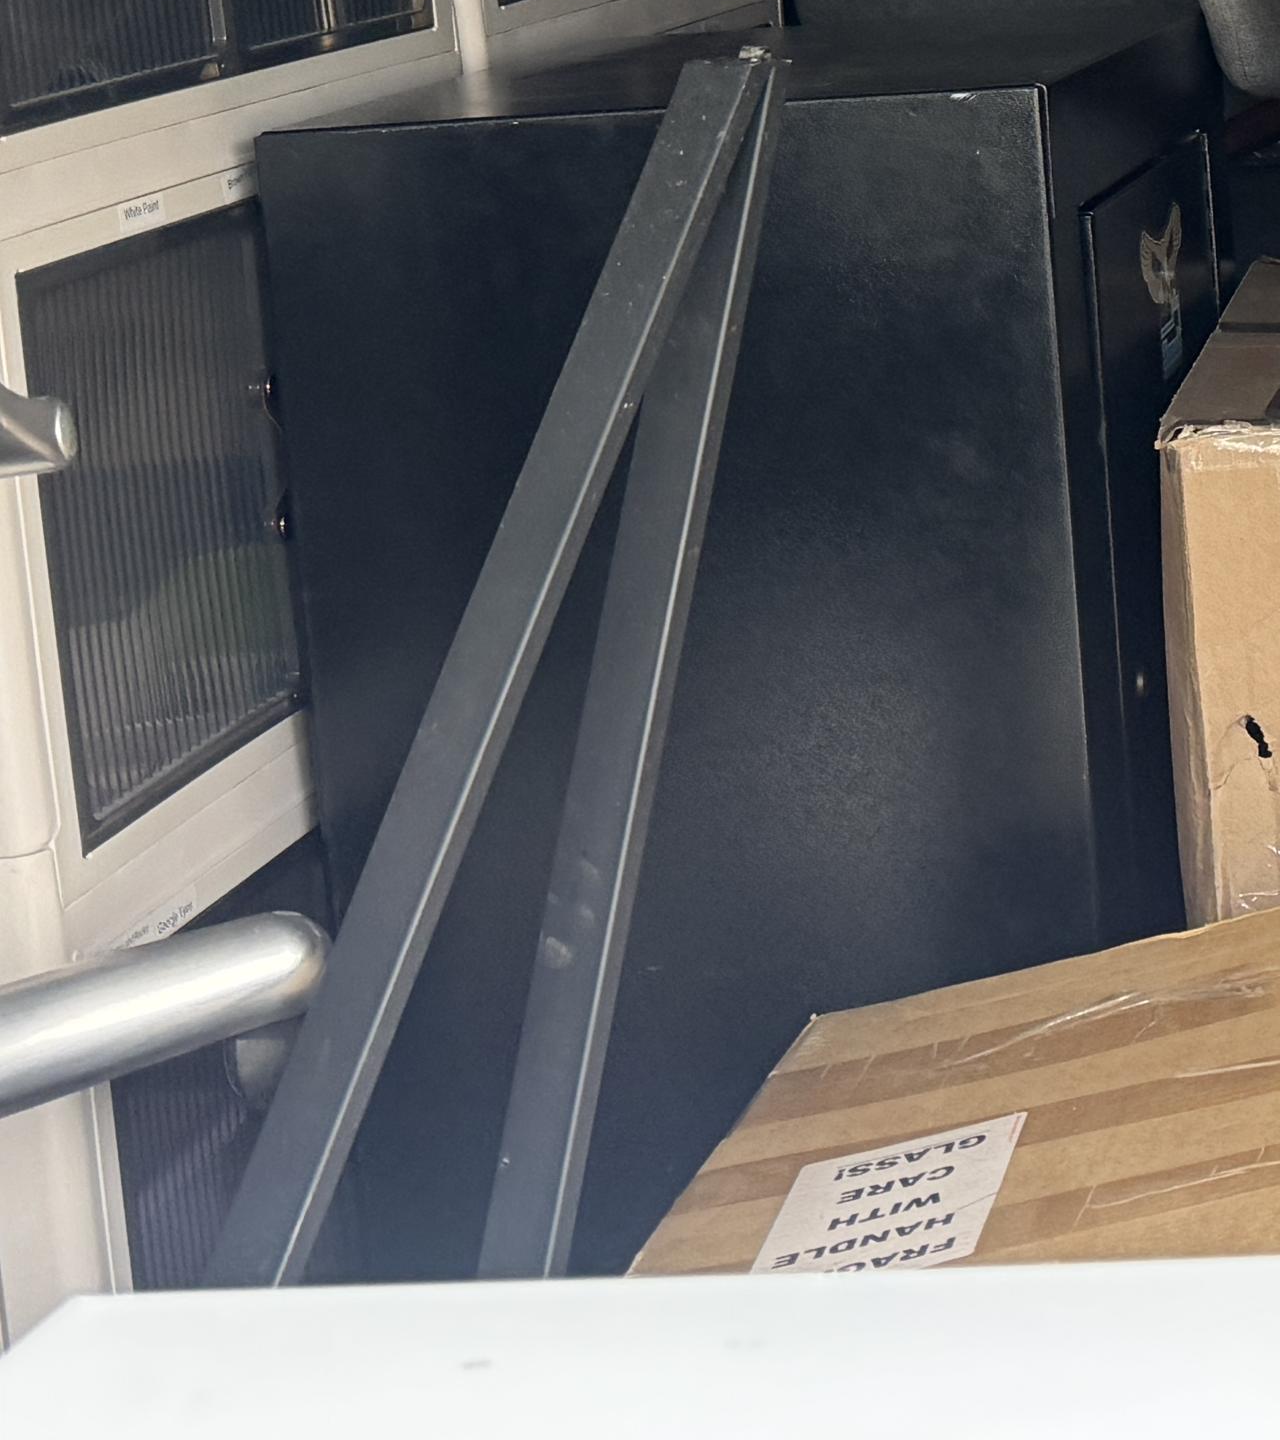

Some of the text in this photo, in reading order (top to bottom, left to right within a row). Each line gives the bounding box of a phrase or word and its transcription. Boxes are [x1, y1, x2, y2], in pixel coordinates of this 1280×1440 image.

[833, 1134, 987, 1181] GLASS!
[836, 1165, 955, 1205] CARE
[827, 1192, 941, 1231] WITH
[771, 1212, 956, 1269] HANDLE
